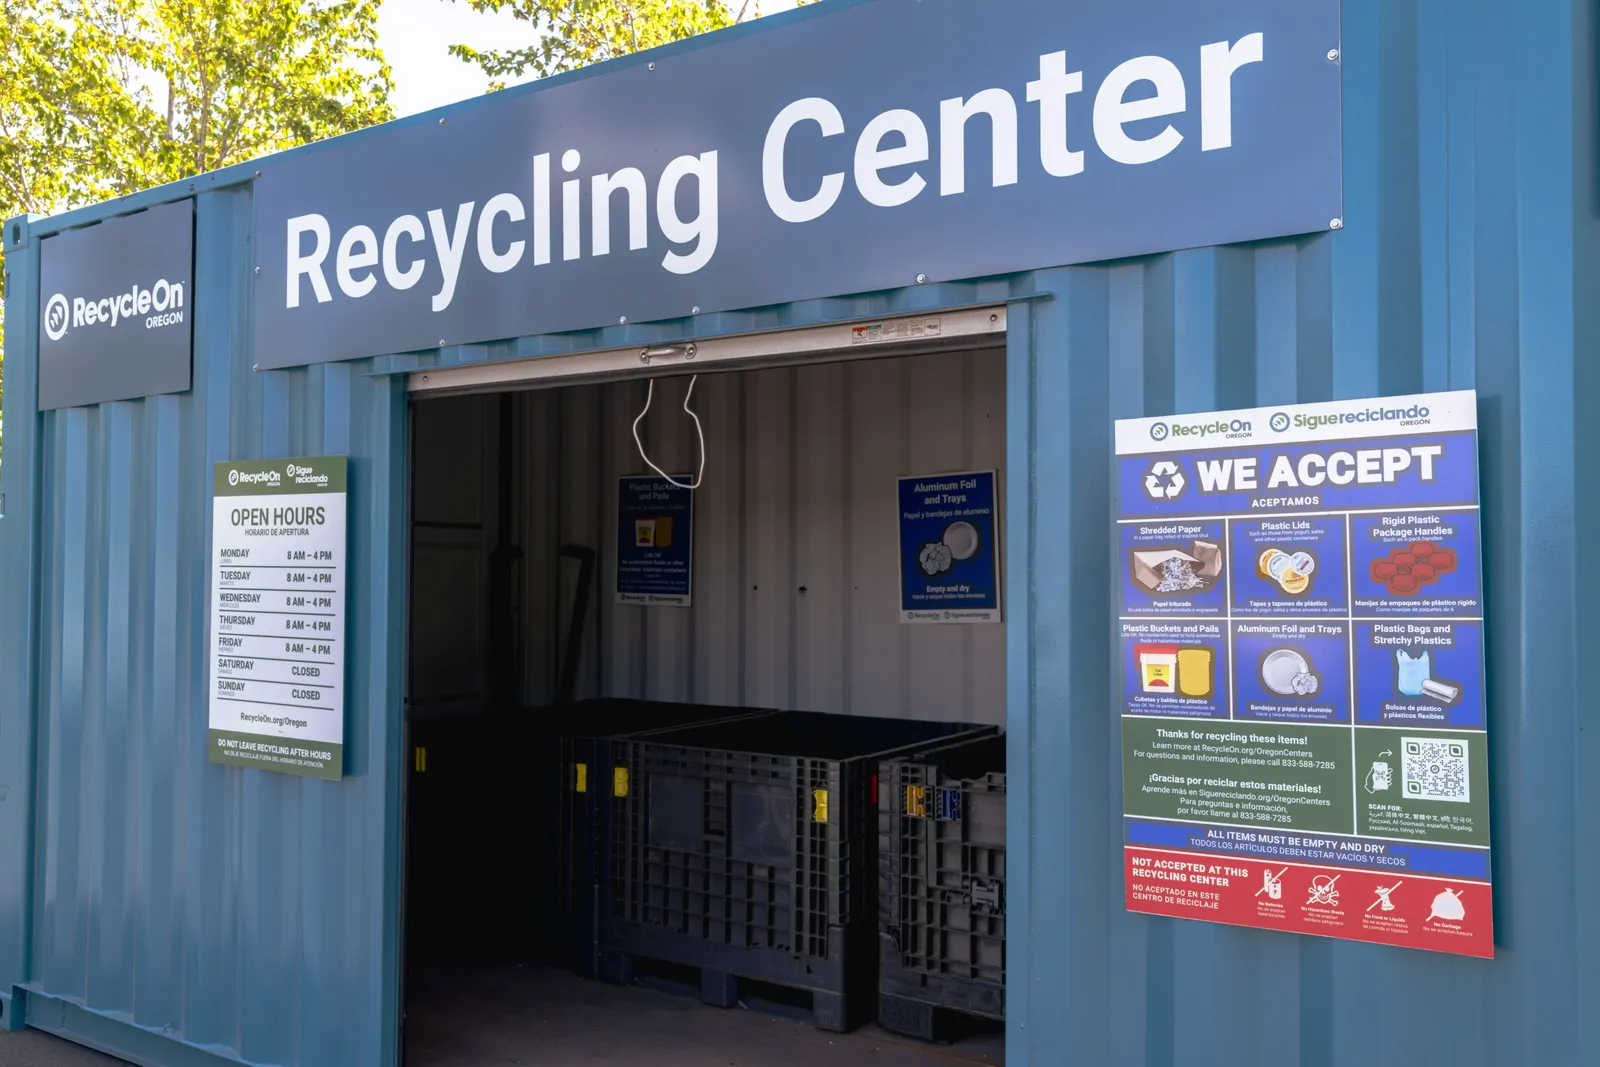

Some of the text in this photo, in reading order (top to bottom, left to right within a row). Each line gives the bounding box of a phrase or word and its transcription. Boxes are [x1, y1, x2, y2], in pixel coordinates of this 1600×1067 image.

[285, 33, 1264, 312] Recycling Center
[73, 279, 184, 328] RecycleOn
[146, 311, 184, 328] OREGON
[1294, 406, 1430, 430] Siguereciclando
[1172, 420, 1252, 437] RecycleOn
[296, 466, 313, 476] Sigue
[1197, 446, 1441, 491] WE ACCEPT
[240, 471, 280, 484] RecycleOn
[296, 474, 328, 483] reciclando
[914, 479, 976, 492] Aluminum Foil
[924, 494, 966, 504] and Trays
[1252, 496, 1319, 508] ACEPTAMOS
[231, 506, 325, 526] OPEN HOURS
[1383, 515, 1440, 527] Rigid Plastic
[1140, 526, 1176, 534] Shredded
[1262, 521, 1310, 530] Plastic Lids
[1373, 527, 1453, 538] Package Handles
[221, 549, 250, 557] MONDAY
[287, 551, 292, 560] 8
[293, 551, 305, 560] AM
[313, 551, 318, 560] 4
[320, 551, 332, 560] PM
[220, 571, 251, 580] TUESDAY
[287, 573, 291, 582] 8
[293, 573, 305, 582] AM
[313, 574, 318, 583] 4
[319, 574, 332, 583] PM
[220, 593, 261, 603] WEDNESDAY
[286, 597, 291, 606] 8
[292, 597, 304, 606] AM
[313, 598, 317, 607] 4
[319, 598, 331, 607] PM
[220, 615, 255, 625] THURSDAY
[286, 620, 290, 629] 8
[292, 620, 304, 630] AM
[312, 621, 317, 630] 4
[319, 621, 331, 631] PM
[1282, 625, 1297, 633] Foil
[1317, 625, 1342, 635] Trays
[1374, 625, 1450, 635] Plastic Bags and
[219, 637, 242, 647] FRIDAY
[1374, 636, 1452, 646] Stretchy Plastics
[286, 643, 290, 652] 8
[292, 644, 304, 653] AM
[312, 645, 316, 654] 4
[318, 645, 330, 655] PM
[219, 659, 254, 670] SATURDAY
[292, 666, 320, 677] CLOSED
[218, 681, 245, 691] SUNDAY
[292, 689, 320, 700] CLOSED
[241, 713, 307, 728] RecycleOn.org/Oregon
[1157, 729, 1307, 745] Thanks for recycling these items!
[218, 738, 331, 760] DO NOT LEAVE RECYCLING AFTER HOURS
[1202, 744, 1313, 758] RecycleOn.org/OregonCenters
[1197, 754, 1240, 764] information,
[1282, 759, 1335, 769] 833-588-7285
[1150, 774, 1321, 794] ¡Gracias por reciclar estos materiales!
[1142, 785, 1170, 794] Aprende
[1199, 790, 1330, 806] Siguereciclando.org/OregonCenters
[1180, 797, 1196, 805] Para
[1198, 800, 1234, 808] preguntas
[1242, 802, 1288, 813] información,
[1191, 807, 1209, 816] favor
[1210, 809, 1230, 818] llame
[1240, 812, 1292, 823] 833-588-7285
[1208, 830, 1385, 854] ALL ITEMS MUST BE EMPTY AND DRY
[1191, 838, 1217, 848] TODOS
[1234, 843, 1278, 854] ARTÍCULOS
[1279, 847, 1306, 856] DEBEN
[1308, 850, 1334, 859] ESTAR
[1336, 853, 1368, 862] VACÍOS
[1376, 856, 1406, 866] SECOS
[1132, 857, 1248, 878] NOT ACCEPTED AT THIS
[1133, 868, 1229, 887] RECYCLING CENTER
[1133, 884, 1143, 894] NO
[1146, 886, 1186, 896] ACEPTADO
[1200, 892, 1219, 901] ESTE
[1133, 892, 1163, 902] CENTRO
[1177, 898, 1218, 909] RECICLAJE
